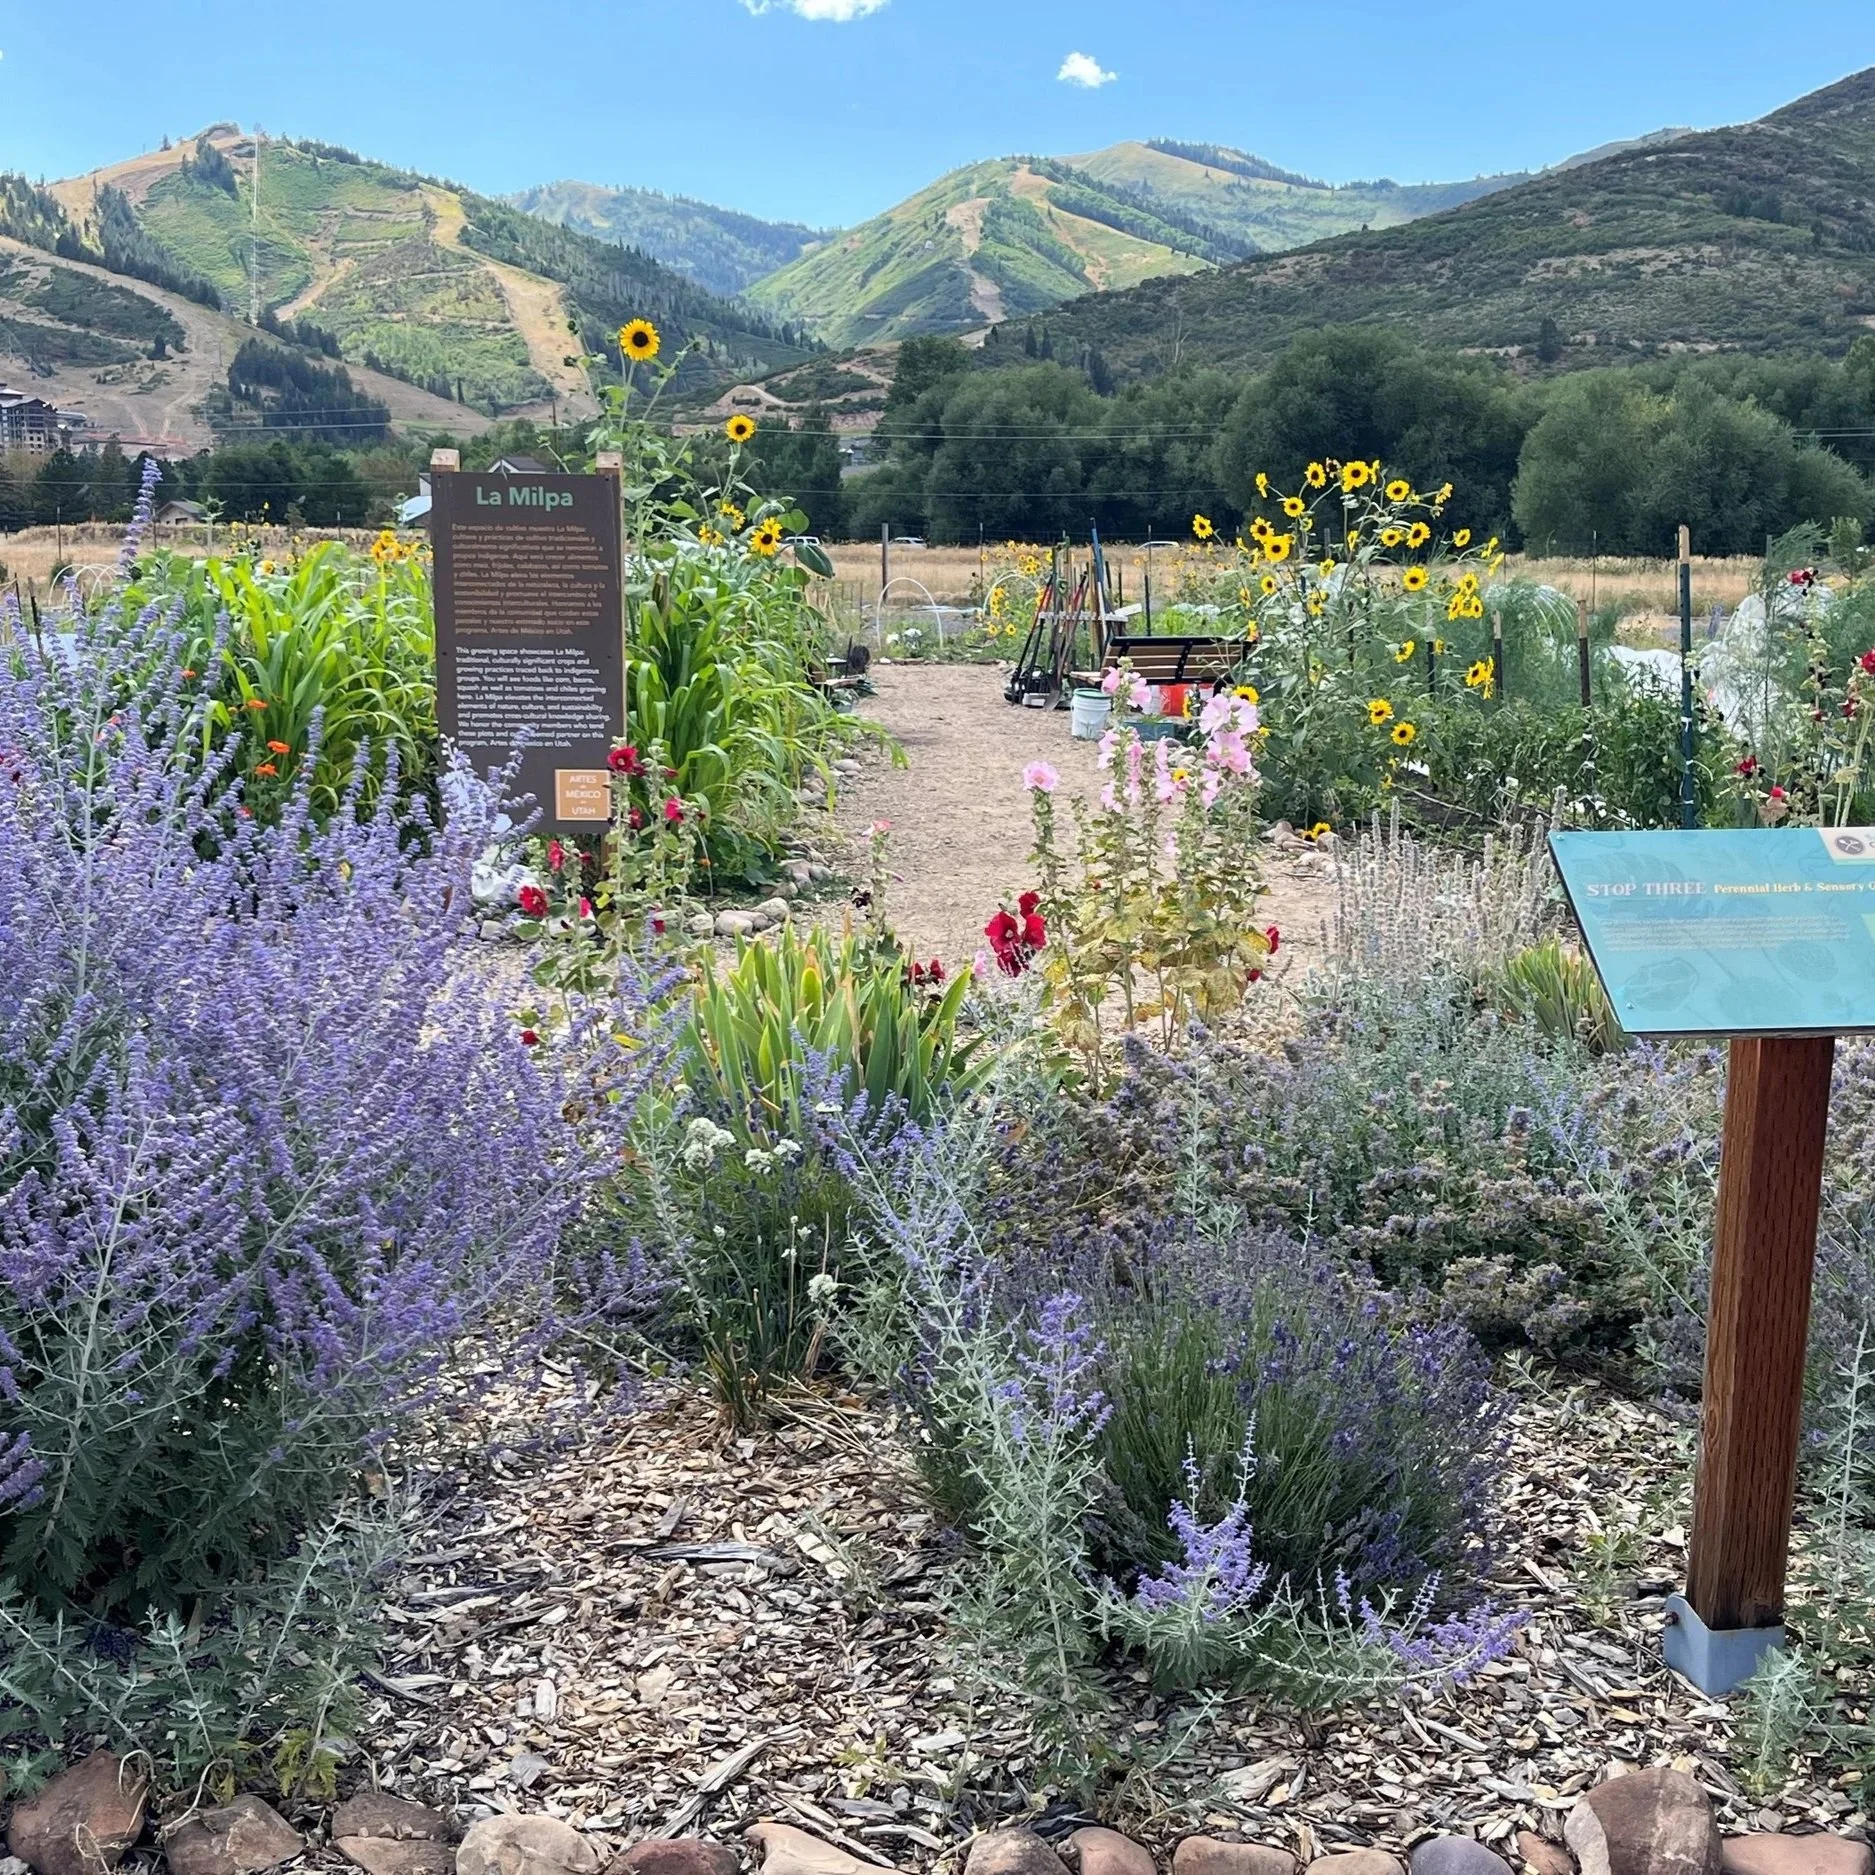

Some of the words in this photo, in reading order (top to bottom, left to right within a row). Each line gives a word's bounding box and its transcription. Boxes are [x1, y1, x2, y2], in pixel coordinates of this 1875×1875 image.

[476, 486, 502, 505] La
[508, 486, 573, 512] Milpa
[456, 646, 469, 654] This
[470, 648, 498, 656] growing
[499, 648, 518, 656] space
[523, 657, 555, 666] significant
[456, 666, 483, 674] growing
[485, 666, 514, 674] practices
[580, 686, 606, 694] growing
[485, 693, 503, 701] Milpa
[569, 775, 597, 783] ARTES
[572, 807, 596, 815] UTAH
[1587, 883, 1637, 897] STOP
[1643, 881, 1707, 896] THREE
[1714, 883, 1770, 894] Perennial
[1774, 882, 1802, 893] Herb
[1804, 882, 1813, 892] &
[1816, 882, 1865, 893] Sensory
